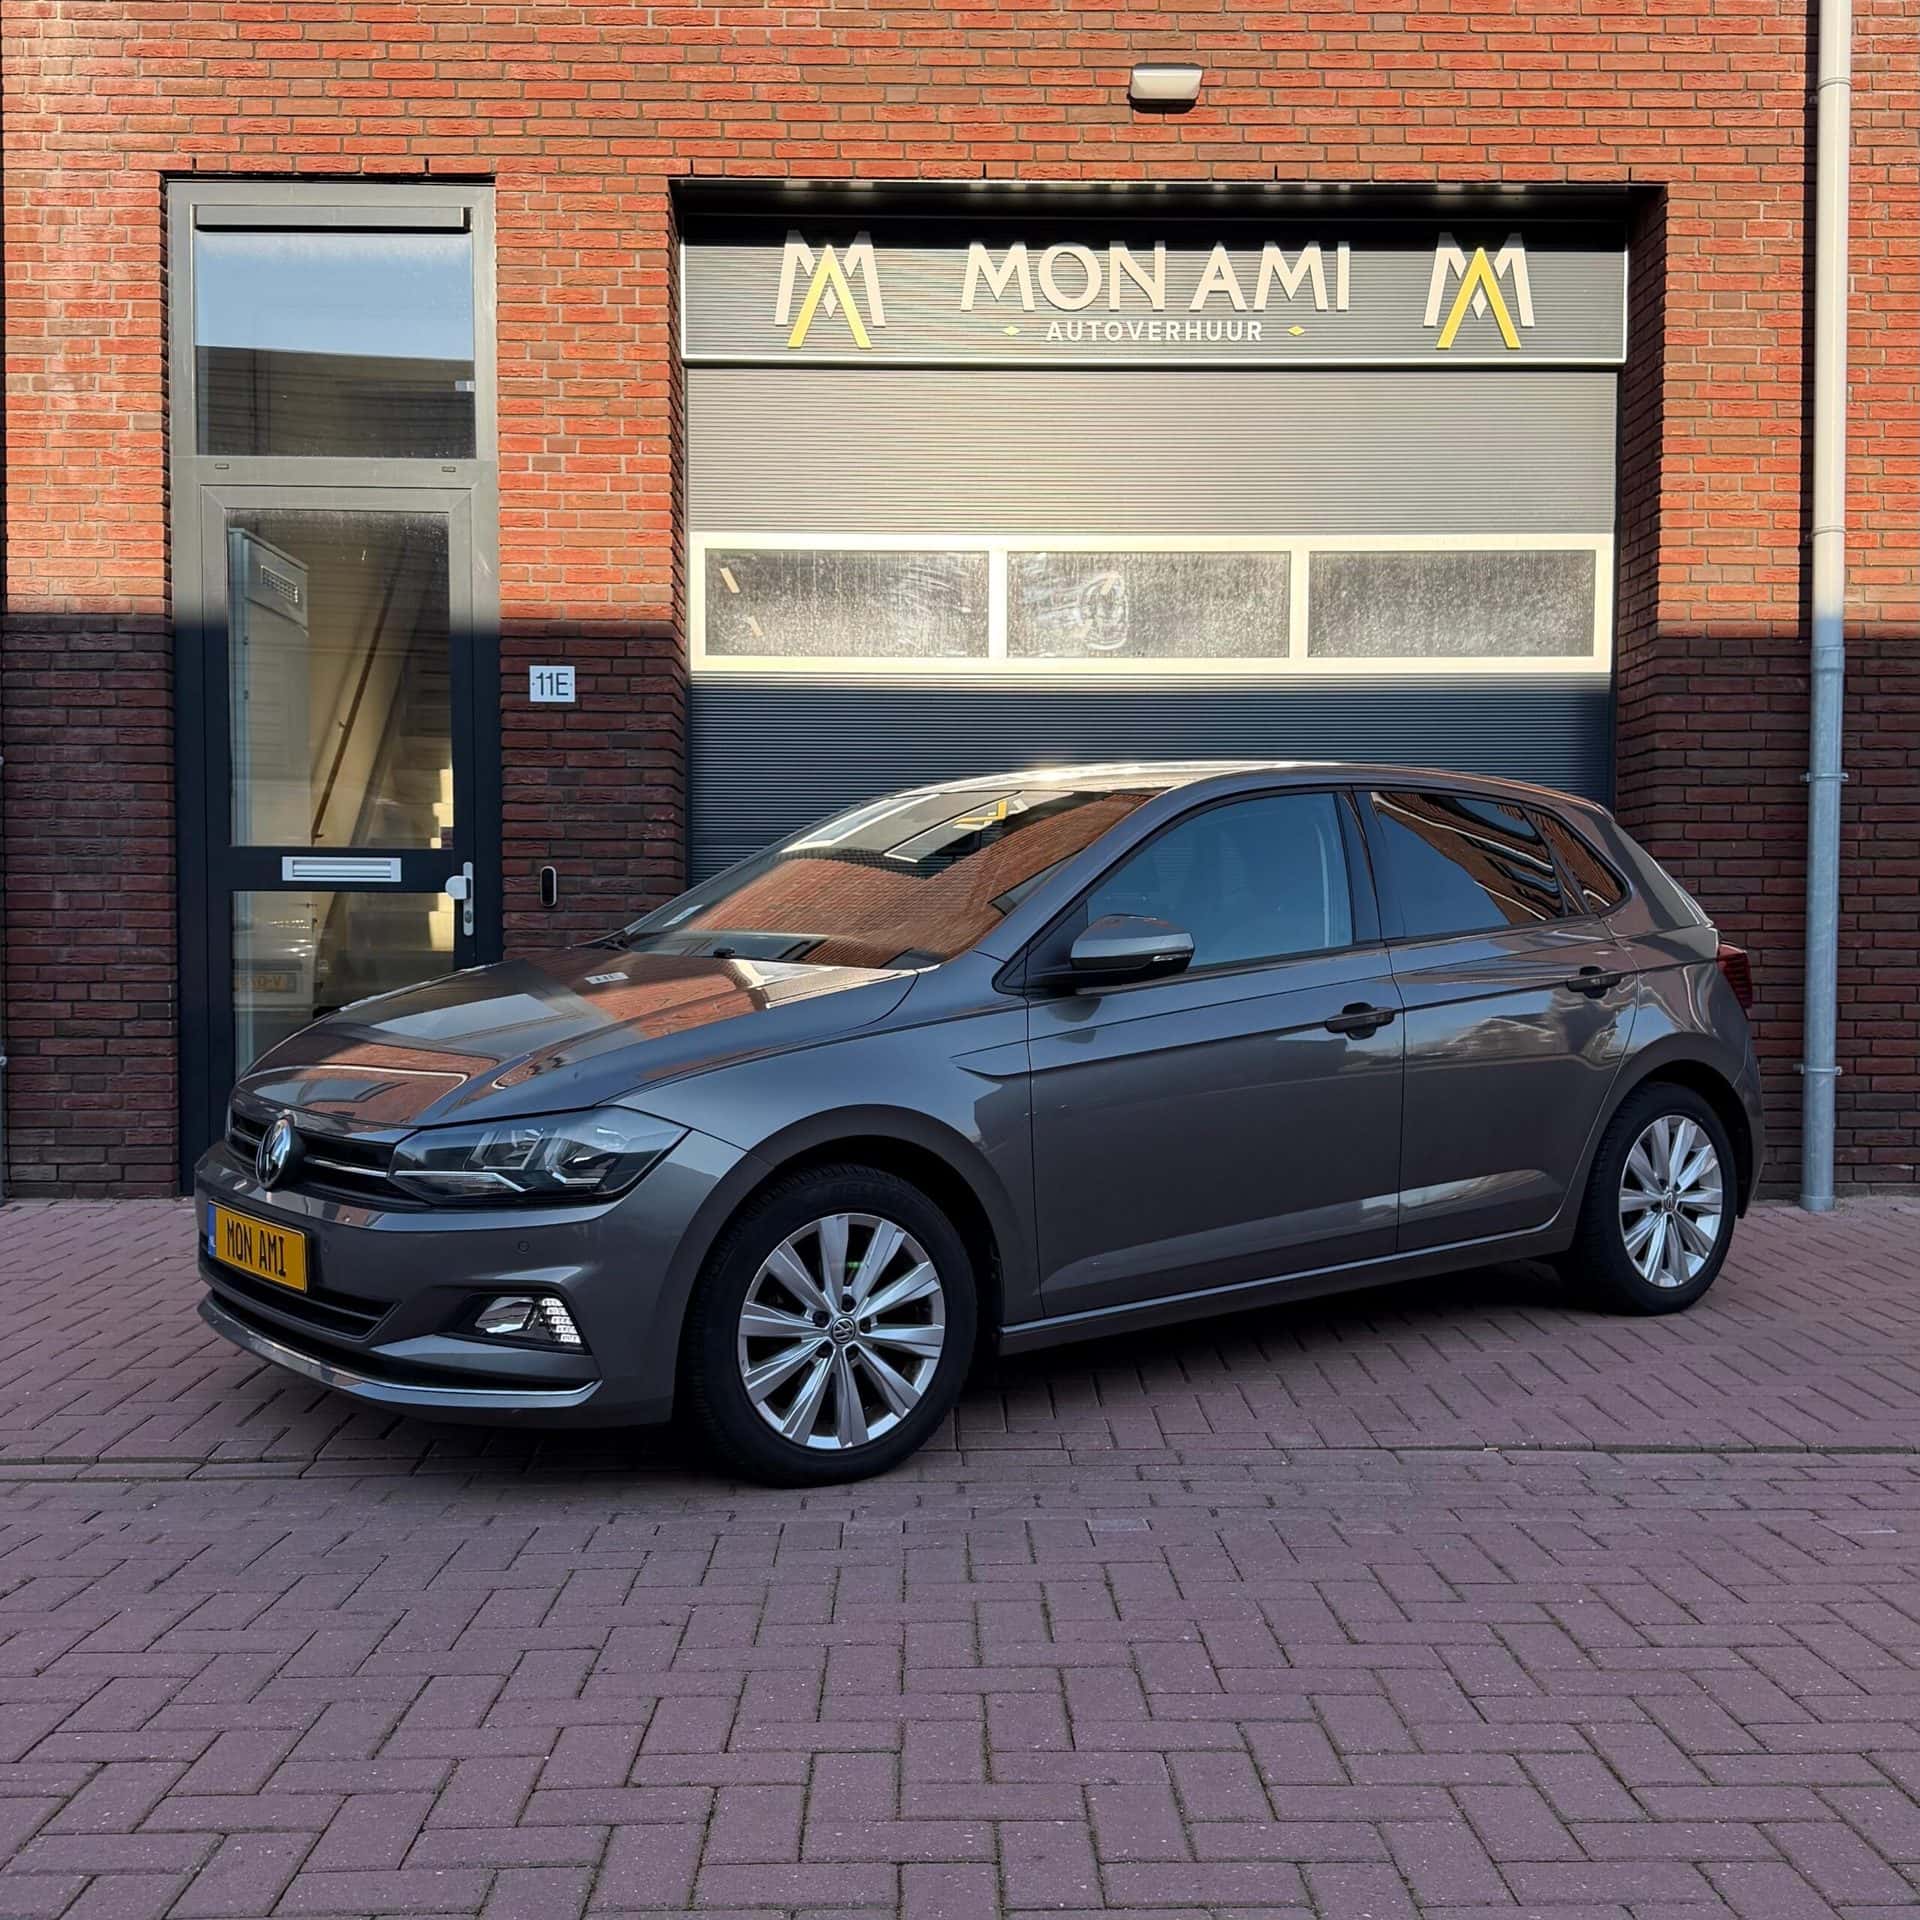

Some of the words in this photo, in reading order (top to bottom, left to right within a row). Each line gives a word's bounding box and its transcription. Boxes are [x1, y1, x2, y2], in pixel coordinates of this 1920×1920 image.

[960, 240, 1166, 312] MON
[1189, 240, 1351, 312] AMI
[1045, 319, 1263, 342] AUTOVERHUUR
[535, 672, 569, 696] 11E
[226, 1216, 253, 1265] MON
[259, 1229, 286, 1277] AMI
